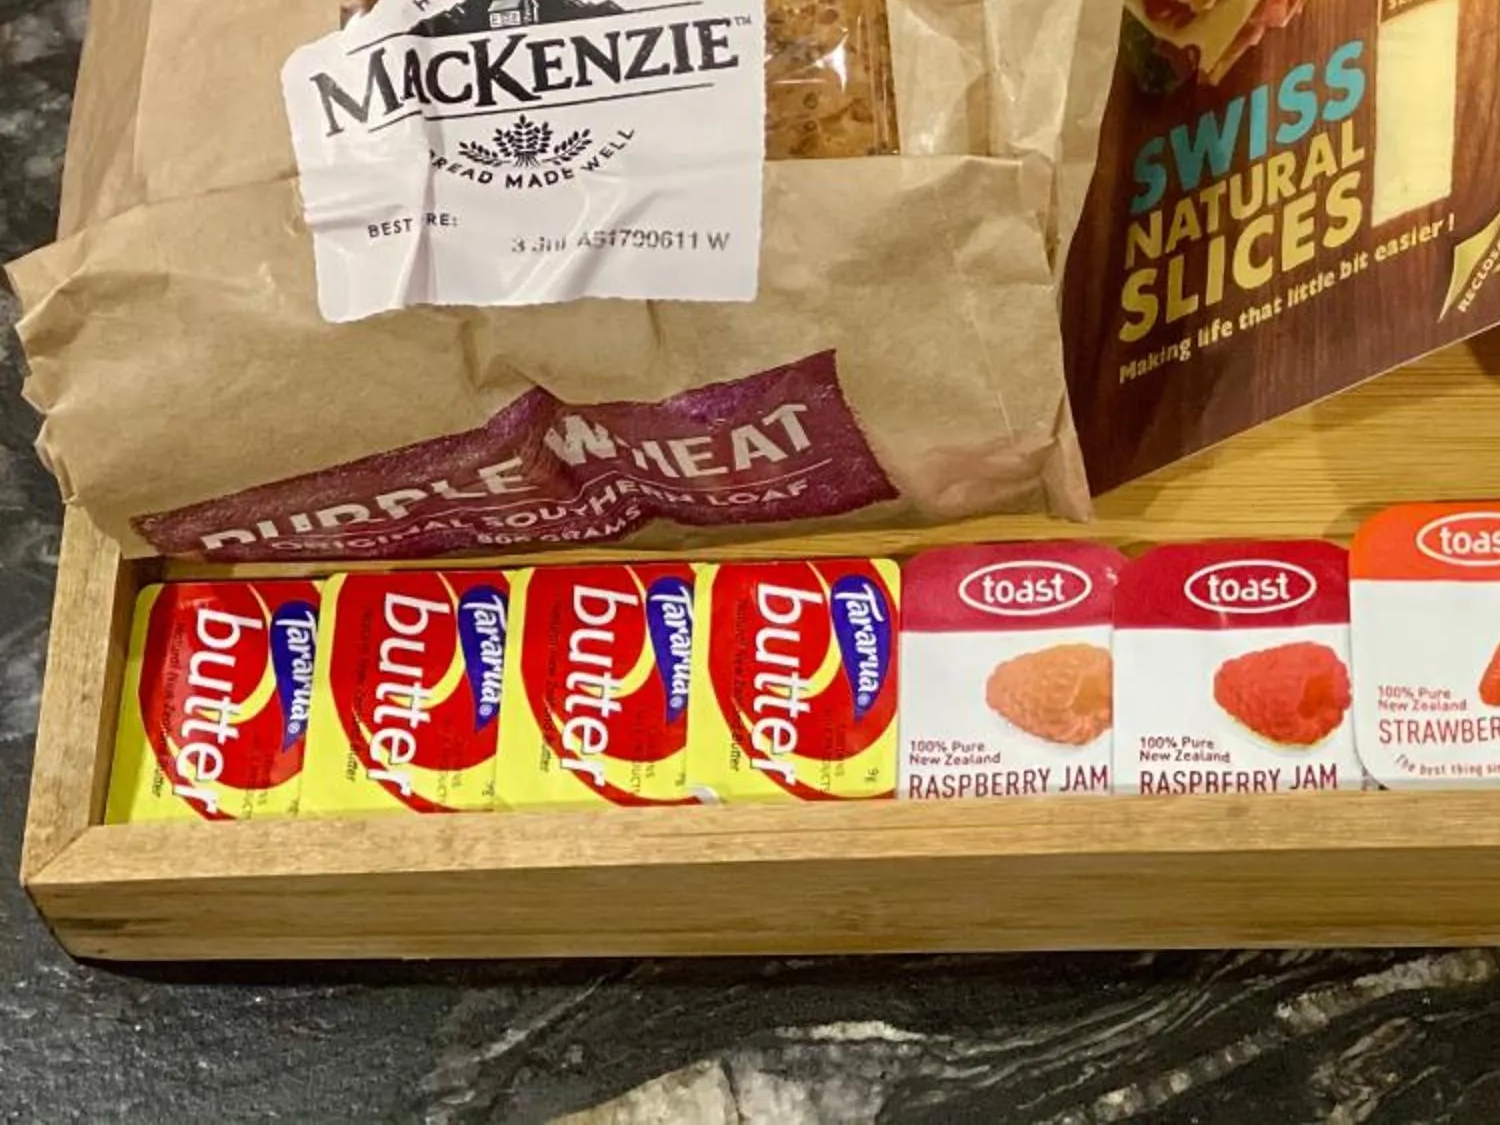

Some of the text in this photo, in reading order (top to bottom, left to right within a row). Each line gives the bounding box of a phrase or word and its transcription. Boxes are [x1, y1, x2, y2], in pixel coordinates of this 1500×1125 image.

[1130, 40, 1366, 215] SWISS
[505, 168, 575, 189] MADE
[580, 128, 635, 173] WELL
[1124, 120, 1365, 270] NATURAL
[368, 217, 414, 239] BEST
[707, 232, 731, 251] W
[1119, 171, 1363, 343] SLICES
[1118, 334, 1193, 385] Making
[1197, 321, 1234, 348] life
[1238, 302, 1283, 332] that
[1286, 269, 1336, 309] little
[1339, 250, 1369, 280] bit
[982, 574, 1067, 605] toast
[1207, 572, 1291, 603] toast
[275, 610, 318, 722] Tararua
[462, 594, 507, 706] Tararua
[649, 586, 693, 696] Tararua
[834, 583, 885, 698] Tararua
[174, 608, 263, 814] butter
[367, 592, 450, 796] butter
[560, 584, 639, 788] butter
[750, 582, 824, 786] butter
[1377, 698, 1468, 713] New Zealand
[1418, 687, 1452, 700] Pure
[909, 740, 986, 753] 100% Pure
[909, 752, 1001, 767] New Zealand
[1139, 736, 1215, 750] 100% Pure
[1139, 749, 1231, 764] New Zealand
[909, 768, 1052, 800] RASPBERRY
[1059, 764, 1109, 793] JAM
[1139, 763, 1338, 795] RASPBERRY JAM
